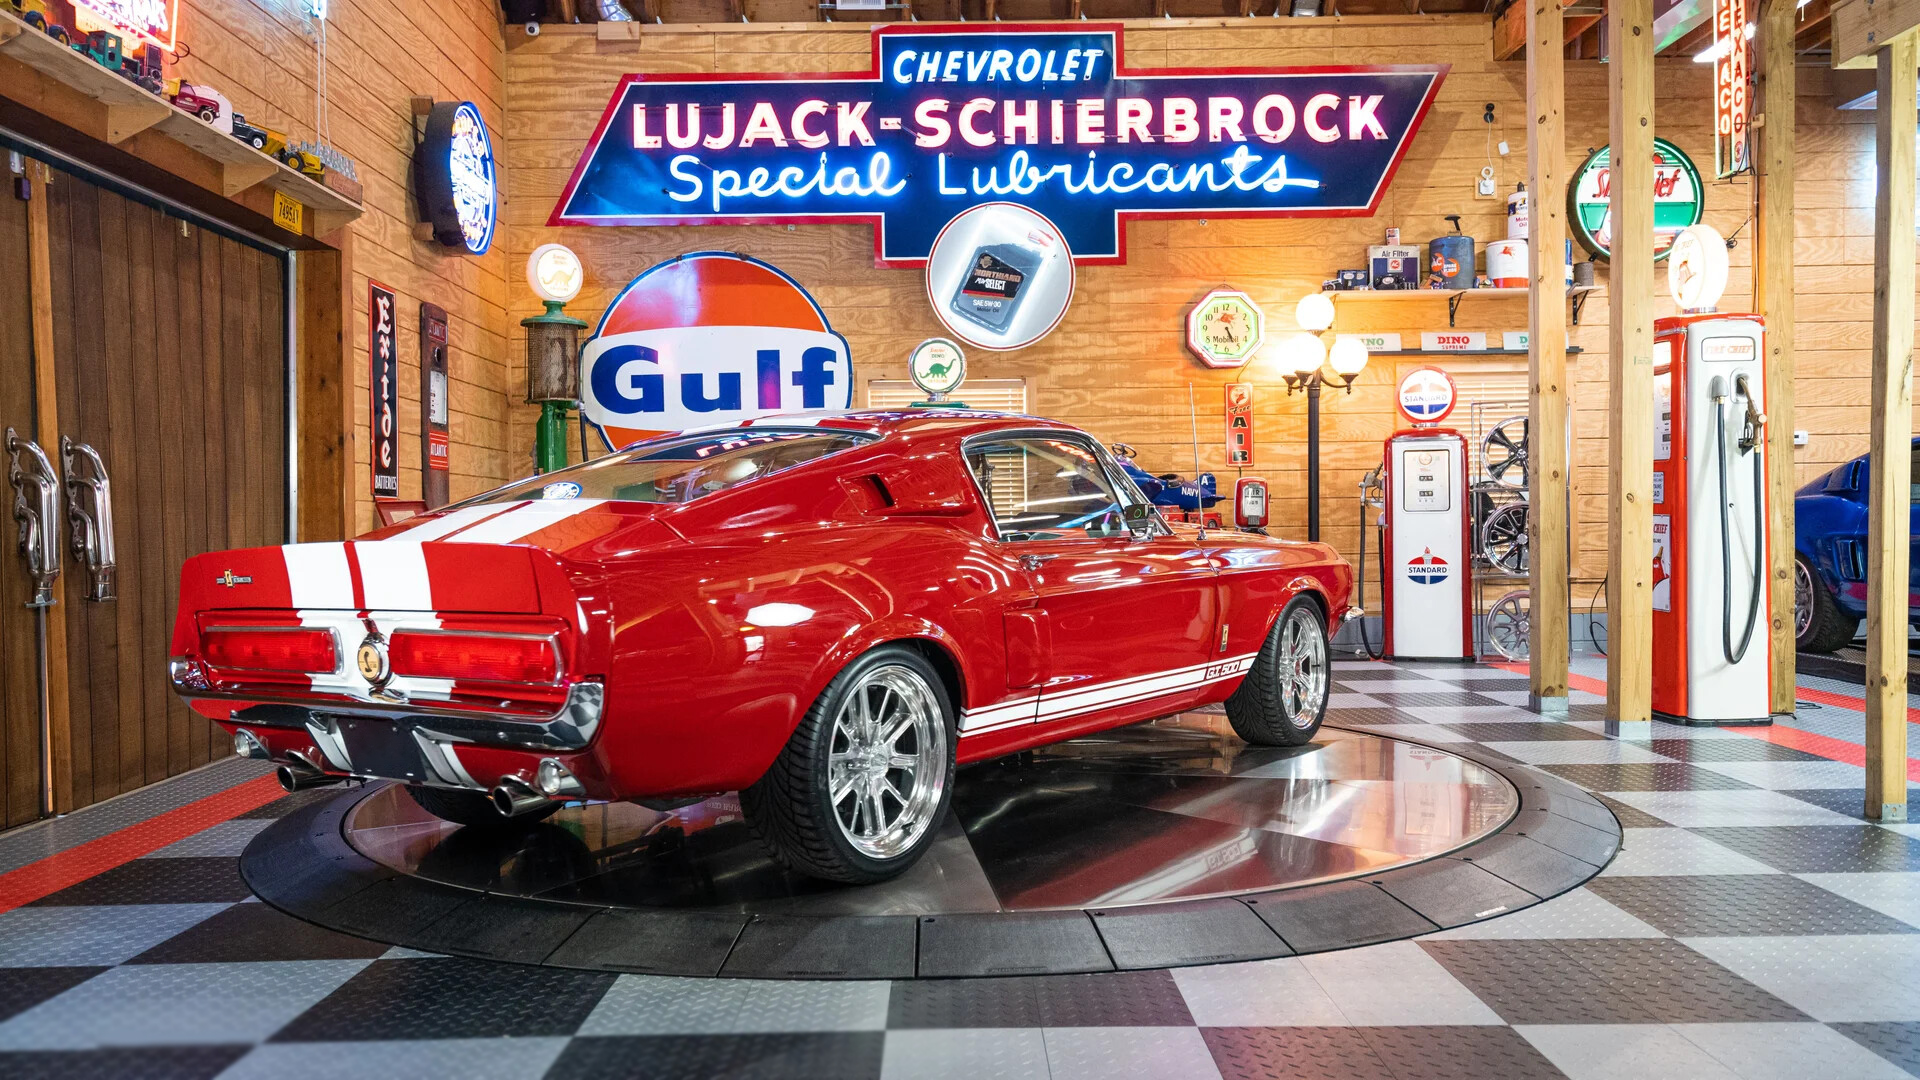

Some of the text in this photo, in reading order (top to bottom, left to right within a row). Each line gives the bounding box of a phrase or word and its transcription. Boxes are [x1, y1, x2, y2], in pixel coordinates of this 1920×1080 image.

[893, 48, 1104, 83] CHEVROLET
[632, 93, 1389, 149] LUJACK-SCHIERBROCK
[667, 145, 1321, 212] Special Lubricants
[1222, 303, 1230, 311] 12
[1205, 313, 1213, 321] 10
[1202, 324, 1208, 332] 9
[1437, 336, 1470, 344] DINO
[375, 295, 392, 469] Exide
[591, 344, 837, 415] Gulf
[1228, 405, 1251, 415] Free
[1231, 416, 1248, 462] AIR
[430, 443, 448, 458] ATLANTIC
[374, 475, 397, 489] BATTERIES
[1201, 475, 1209, 485] A
[1181, 486, 1199, 497] NAVY
[1408, 566, 1448, 574] STANDARD
